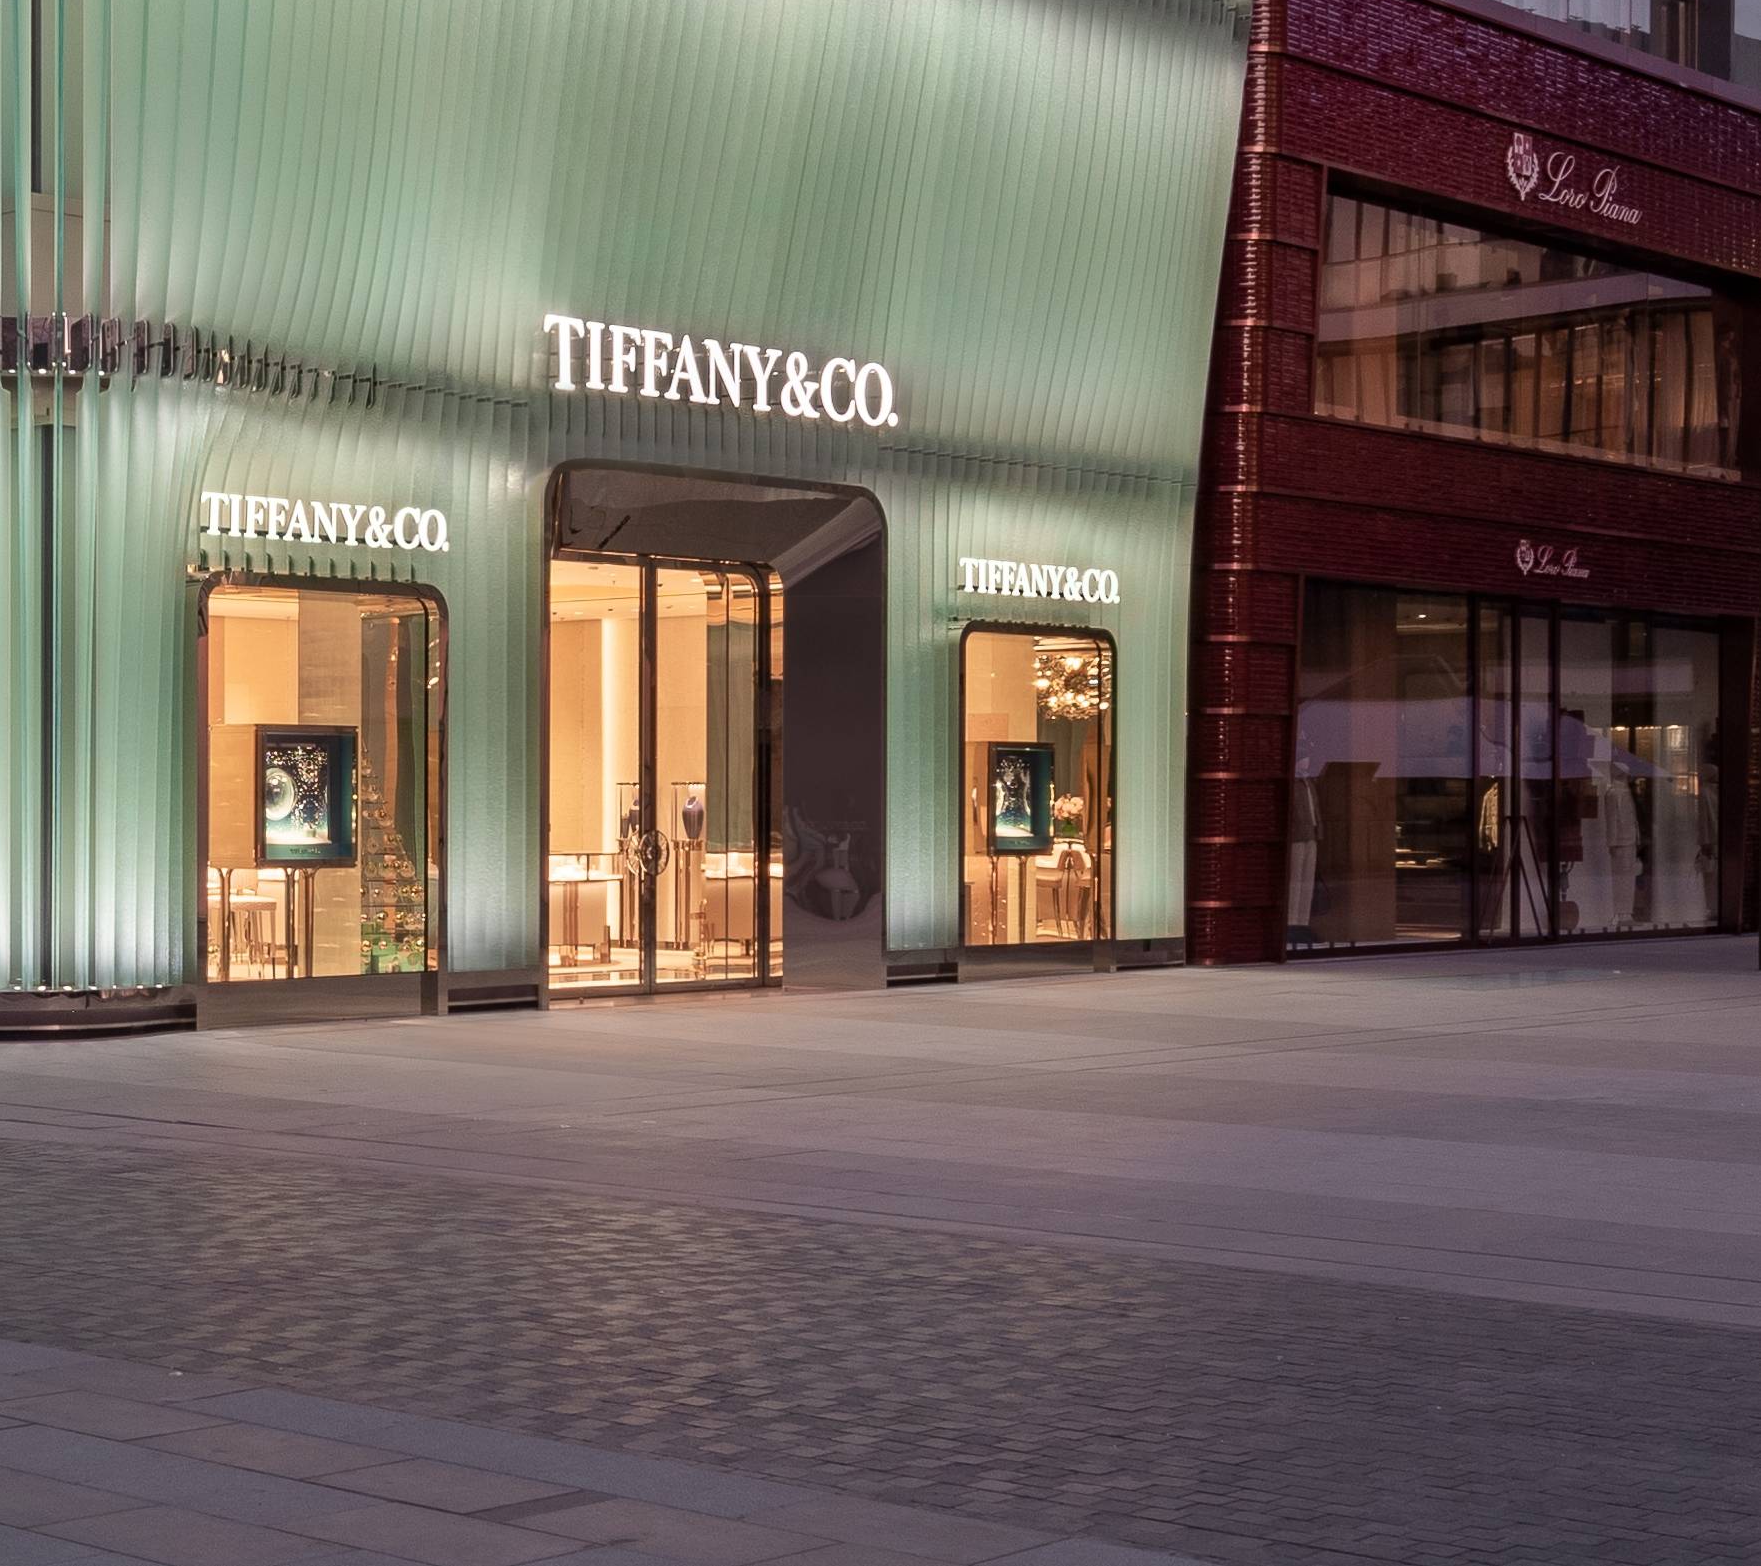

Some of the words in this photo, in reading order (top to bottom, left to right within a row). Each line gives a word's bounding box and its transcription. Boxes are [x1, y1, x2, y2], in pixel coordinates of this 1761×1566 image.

[1539, 151, 1589, 209] Loro
[1590, 165, 1643, 224] Piana
[544, 314, 899, 426] TIFFANY&CO.
[200, 491, 450, 552] TIFFANY&CO.
[959, 557, 1119, 603] TIFFANY&CO.
